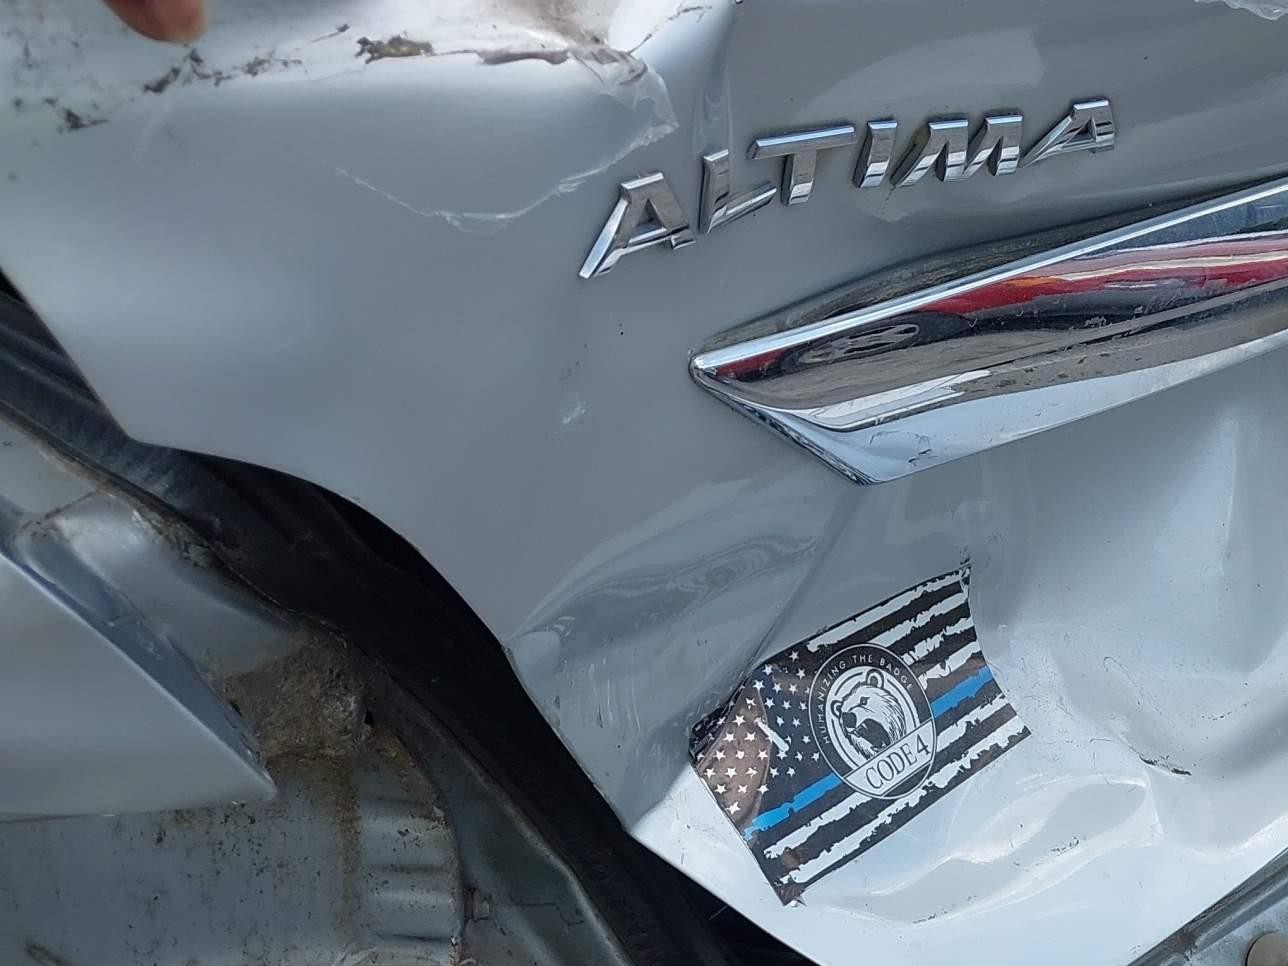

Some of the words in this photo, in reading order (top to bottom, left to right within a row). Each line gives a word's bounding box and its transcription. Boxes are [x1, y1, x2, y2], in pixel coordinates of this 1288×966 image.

[578, 99, 1117, 280] ALTIMA
[817, 660, 846, 744] HUMANIZING
[852, 654, 873, 664] THE
[880, 657, 913, 690] BADGE
[865, 742, 918, 790] CODE
[916, 733, 931, 756] 4
